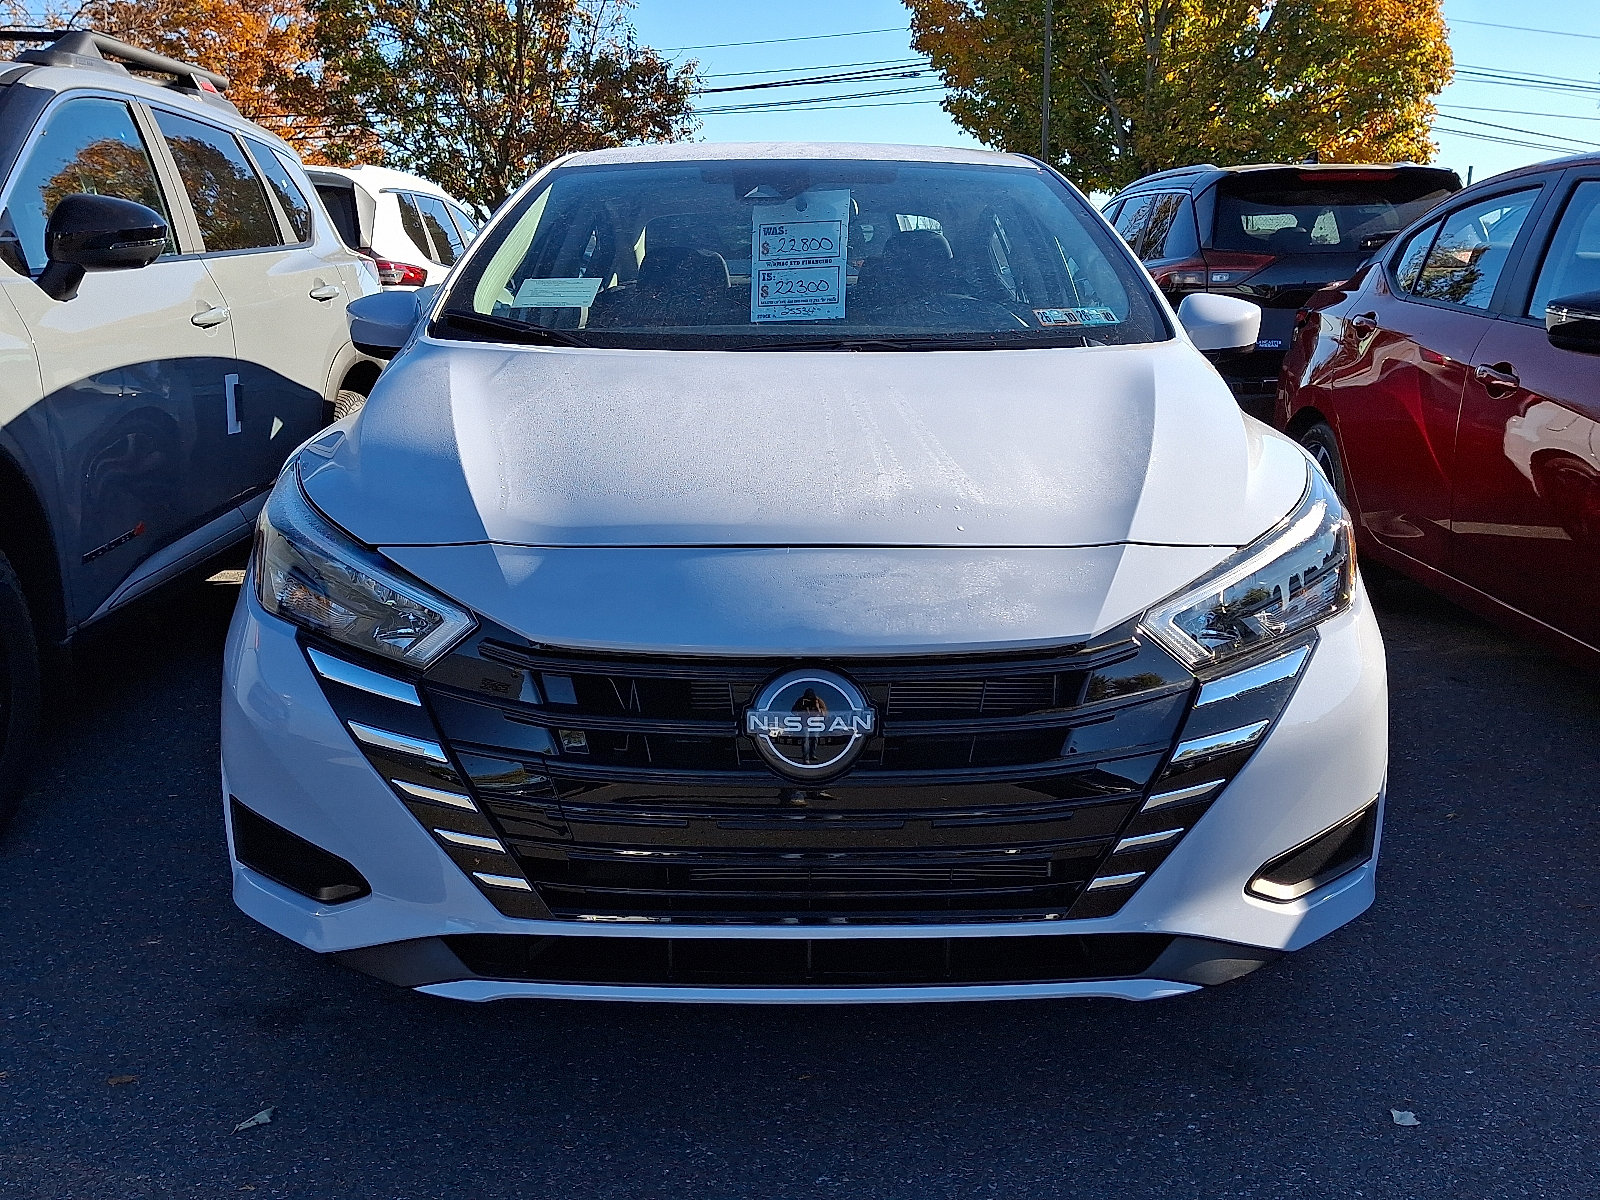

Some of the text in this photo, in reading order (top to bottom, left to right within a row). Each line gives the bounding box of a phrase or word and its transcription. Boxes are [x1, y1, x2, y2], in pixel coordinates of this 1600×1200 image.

[763, 226, 788, 236] WAS:
[761, 237, 834, 255] $ 22800
[761, 273, 776, 281] IS:
[760, 280, 830, 299] $ 22300
[749, 715, 872, 732] NISSAN
